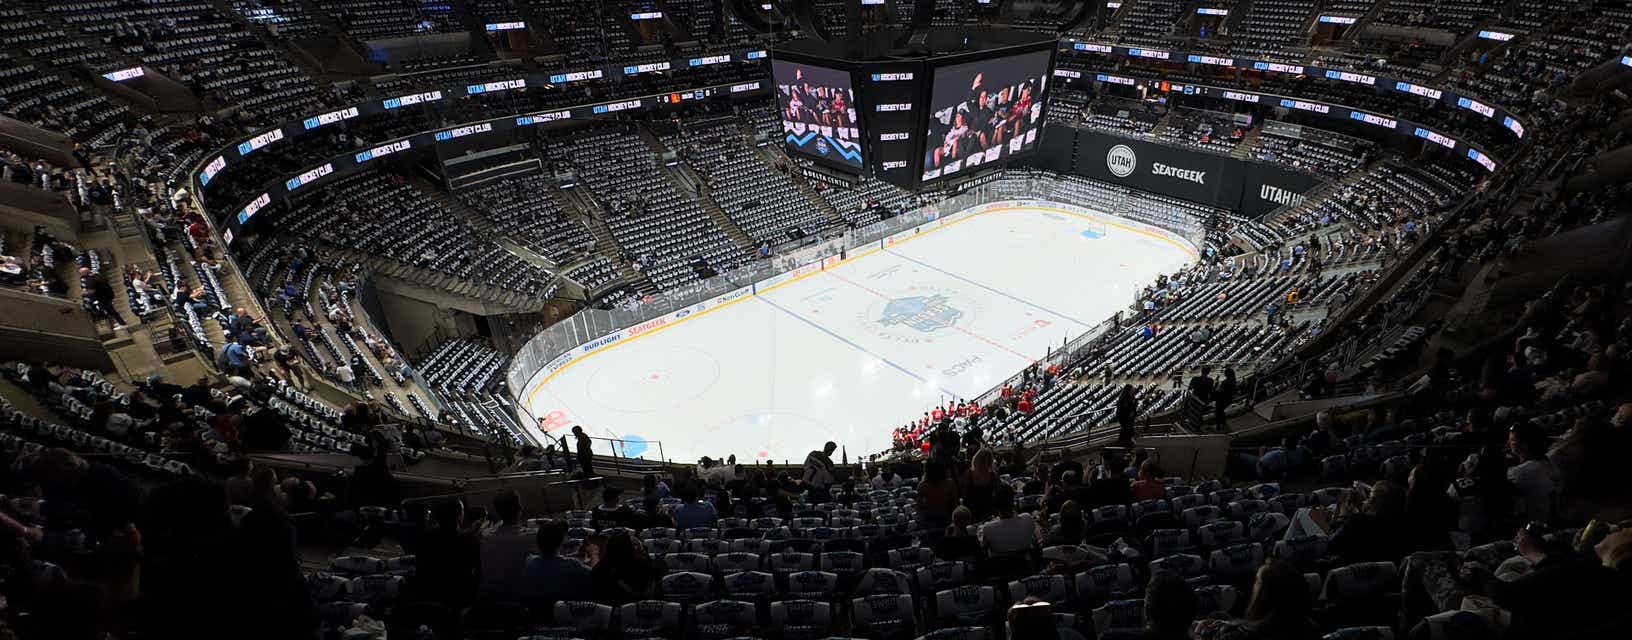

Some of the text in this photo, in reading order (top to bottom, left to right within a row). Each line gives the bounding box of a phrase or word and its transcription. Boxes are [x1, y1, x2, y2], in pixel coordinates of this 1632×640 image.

[700, 56, 717, 64] HOCKEY
[718, 55, 730, 63] CLUB
[1157, 50, 1169, 59] CLUB
[1199, 56, 1220, 64] HOCKEY
[1219, 58, 1233, 66] CLUB
[636, 64, 656, 72] HOCKEY
[656, 62, 670, 71] CLUB
[1254, 62, 1304, 74] UTAH HOCKEY CLUB
[550, 70, 602, 83] UTAH HOCKEY CLUB
[1327, 71, 1375, 85] UTAH HOCKEY CLUB
[468, 79, 525, 94] UTAH HOCKEY CLUB
[384, 91, 442, 109] UTAH HOCKEY CLUB
[1246, 94, 1259, 103] CLUB
[606, 103, 627, 112] HOCKEY
[627, 100, 641, 109] CLUB
[1295, 101, 1315, 112] HOCKEY
[1315, 105, 1329, 114] CLUB
[304, 107, 358, 129] UTAH HOCKEY CLUB
[517, 111, 571, 125] UTAH HOCKEY CLUB
[1363, 114, 1382, 125] HOCKEY
[1382, 118, 1397, 128] CLUB
[436, 123, 491, 141] UTAH HOCKEY CLUB
[357, 140, 410, 163] UTAH HOCKEY CLUB
[1112, 154, 1131, 168] UTAH
[300, 169, 318, 184] HOCKEY
[318, 163, 333, 177] CLUB
[808, 171, 849, 188] DELTA CENTER
[964, 172, 1002, 189] DELTA CENTER
[1152, 162, 1206, 185] SEATGEEK
[1260, 184, 1291, 206] UTAH
[628, 318, 666, 336] SEATGEEK
[584, 334, 621, 352] BUD LIGHT
